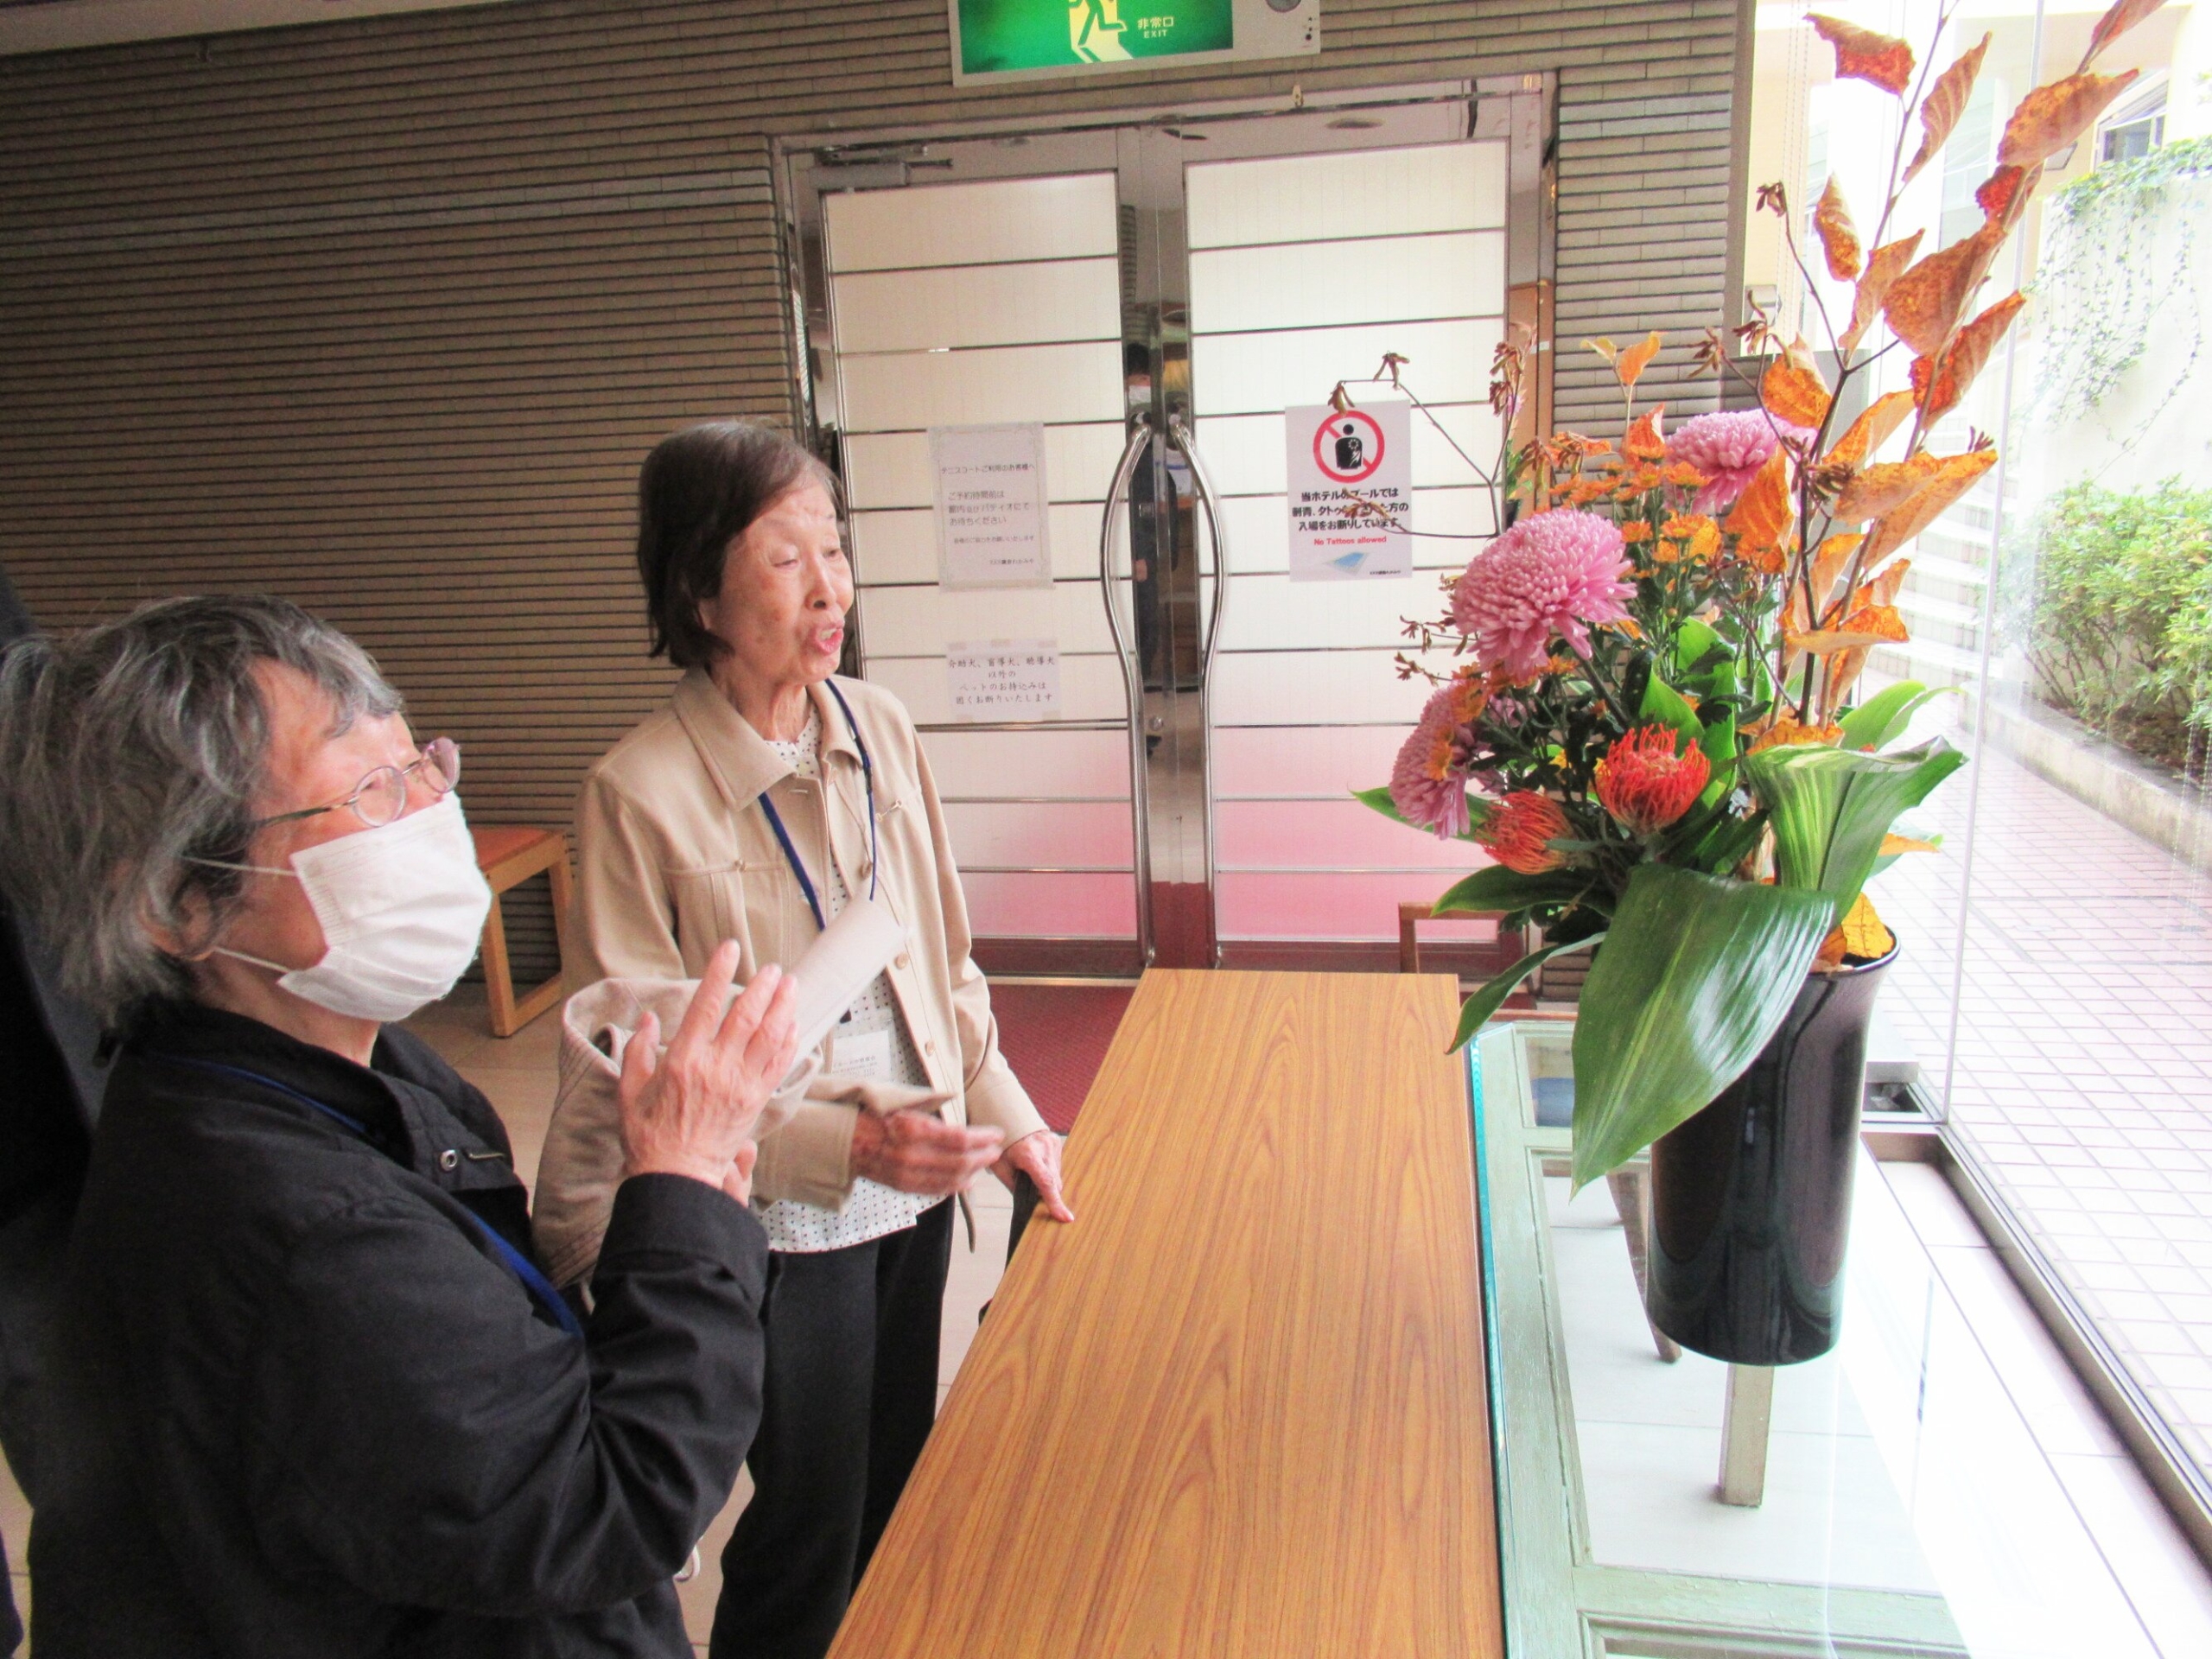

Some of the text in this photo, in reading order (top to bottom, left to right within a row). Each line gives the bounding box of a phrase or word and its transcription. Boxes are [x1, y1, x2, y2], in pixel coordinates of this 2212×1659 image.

[1137, 16, 1174, 30] 非常口
[1144, 29, 1167, 39] EXIT
[950, 517, 1007, 526] お待ちください
[1327, 537, 1355, 545] Tattoos
[1357, 536, 1388, 544] allowed
[988, 671, 1016, 679] 以外の
